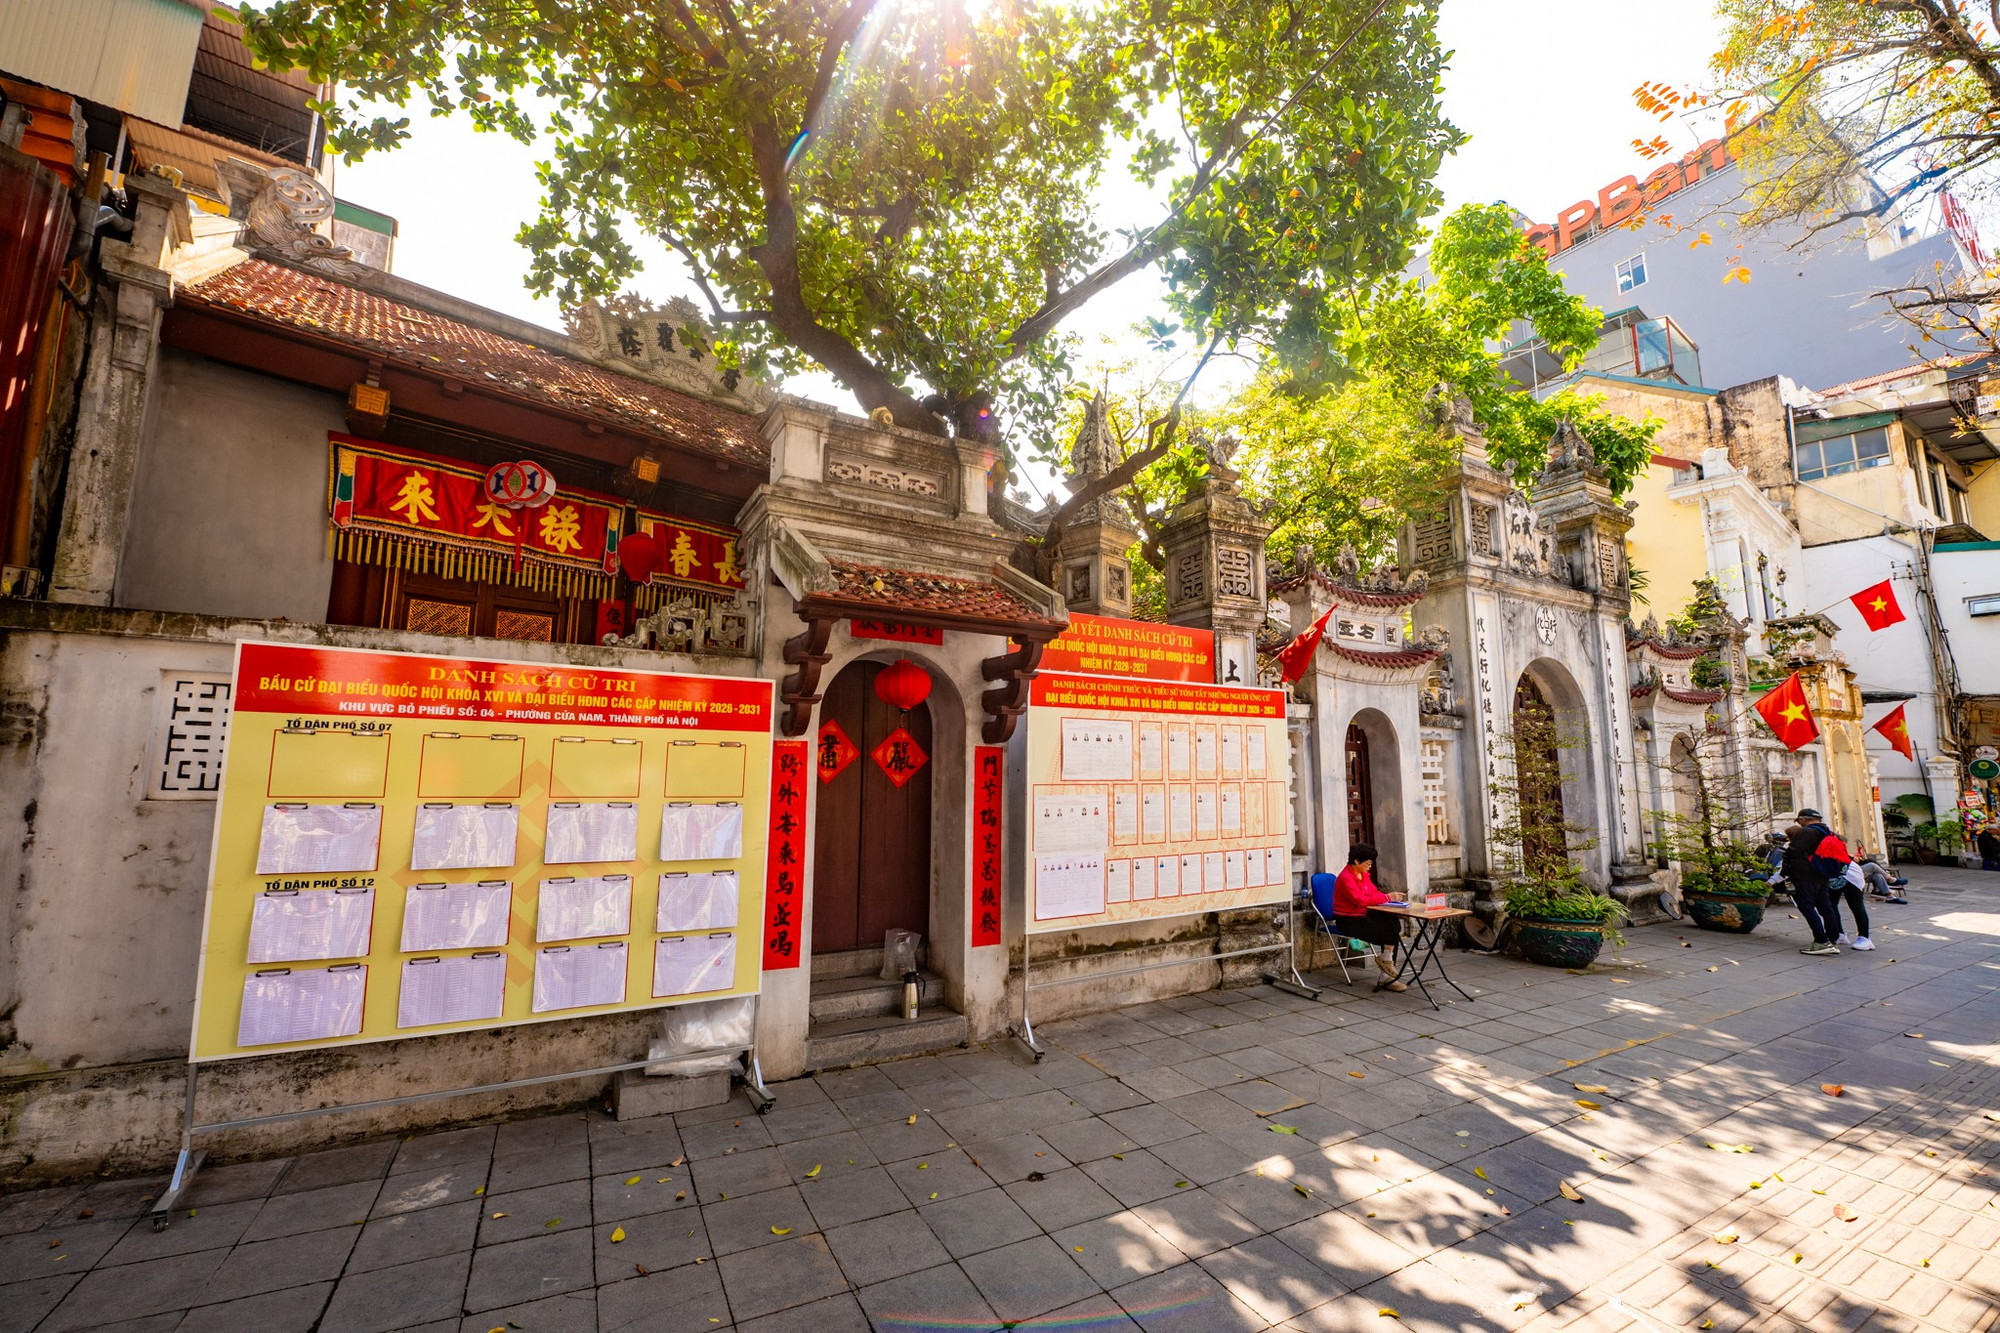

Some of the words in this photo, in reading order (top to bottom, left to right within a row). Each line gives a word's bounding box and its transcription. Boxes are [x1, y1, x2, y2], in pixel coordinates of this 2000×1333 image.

[1516, 112, 1766, 263] GPBan
[1080, 619, 1101, 637] YẾT
[1103, 624, 1132, 640] DANH
[1134, 627, 1160, 644] SÁCH
[1162, 630, 1176, 646] CỬ
[1177, 635, 1193, 648] TRI
[1066, 638, 1085, 652] QUỐC
[1086, 640, 1098, 656] HỘI
[1118, 646, 1129, 657] XVI
[1129, 645, 1138, 658] VÀ
[1139, 647, 1150, 661] ĐẠI
[1150, 647, 1165, 661] BIỂU
[1183, 651, 1196, 664] CÁC
[1196, 651, 1208, 665] CẤP
[1080, 656, 1102, 671] NHIỆM
[1104, 658, 1113, 670] KỲ
[1113, 661, 1130, 672] 2026
[1133, 662, 1148, 673] 2031
[429, 666, 497, 684] DANH
[502, 670, 562, 688] SÁCH
[568, 674, 598, 690] CỬ
[602, 678, 637, 692] TRI
[1053, 680, 1075, 688] DANH
[1076, 680, 1096, 690] SÁCH
[1097, 682, 1121, 692] CHÍNH
[1122, 685, 1141, 695] THỨC
[1142, 685, 1152, 694] VÀ
[1153, 685, 1169, 695] TIỂU
[1170, 687, 1179, 696] SỬ
[1179, 689, 1194, 697] TÓM
[1208, 690, 1229, 699] NHỮNG
[1230, 691, 1249, 700] NGƯỜI
[260, 673, 290, 691] BẦU
[294, 675, 316, 692] CỬ
[317, 680, 342, 696] ĐẠI
[345, 678, 378, 696] BIỂU
[381, 681, 418, 698] QUỐC
[421, 685, 443, 701] HỘI
[447, 686, 480, 701] KHÓA
[484, 690, 504, 703] XVI
[507, 690, 523, 703] VÀ
[525, 693, 546, 707] ĐẠI
[548, 690, 575, 706] BIỂU
[577, 695, 608, 708] HĐND
[610, 694, 632, 709] CÁC
[635, 695, 657, 710] CẤP
[659, 699, 692, 714] NHIỆM
[694, 699, 707, 712] KỲ
[709, 702, 733, 714] 2026
[738, 704, 761, 715] 2031
[1045, 692, 1058, 705] ĐẠI
[1059, 690, 1076, 704] BIỂU
[1077, 692, 1096, 705] QUỐC
[1097, 694, 1109, 707] HỘI
[1129, 697, 1140, 707] XVI
[1141, 697, 1150, 708] VÀ
[1150, 699, 1162, 711] ĐẠI
[1162, 697, 1177, 710] BIỂU
[1195, 701, 1207, 711] CÁC
[1207, 700, 1220, 712] CẤP
[1220, 702, 1238, 714] NHIỆM
[1239, 702, 1246, 713] KỲ
[286, 717, 302, 728] TỔ
[304, 719, 329, 729] DÂN
[333, 719, 357, 730] PHỐ
[360, 720, 376, 731] SỐ
[379, 722, 392, 731] 07
[339, 701, 366, 712] KHU
[369, 702, 395, 714] VỰC
[397, 702, 415, 714] BỎ
[418, 704, 455, 716] PHIẾU
[458, 704, 477, 717] SỐ:
[480, 708, 495, 718] 04
[505, 709, 552, 721] PHƯỜNG
[554, 709, 576, 721] CỬA
[578, 713, 606, 723] NAM,
[608, 712, 642, 724] THÀNH
[644, 713, 664, 724] PHỐ
[666, 715, 680, 725] HÀ
[682, 716, 699, 727] NỘI
[265, 879, 281, 890] TỔ
[284, 879, 310, 890] DÂN
[313, 876, 338, 889] PHỐ
[341, 876, 358, 888] SỐ
[361, 878, 375, 887] 12
